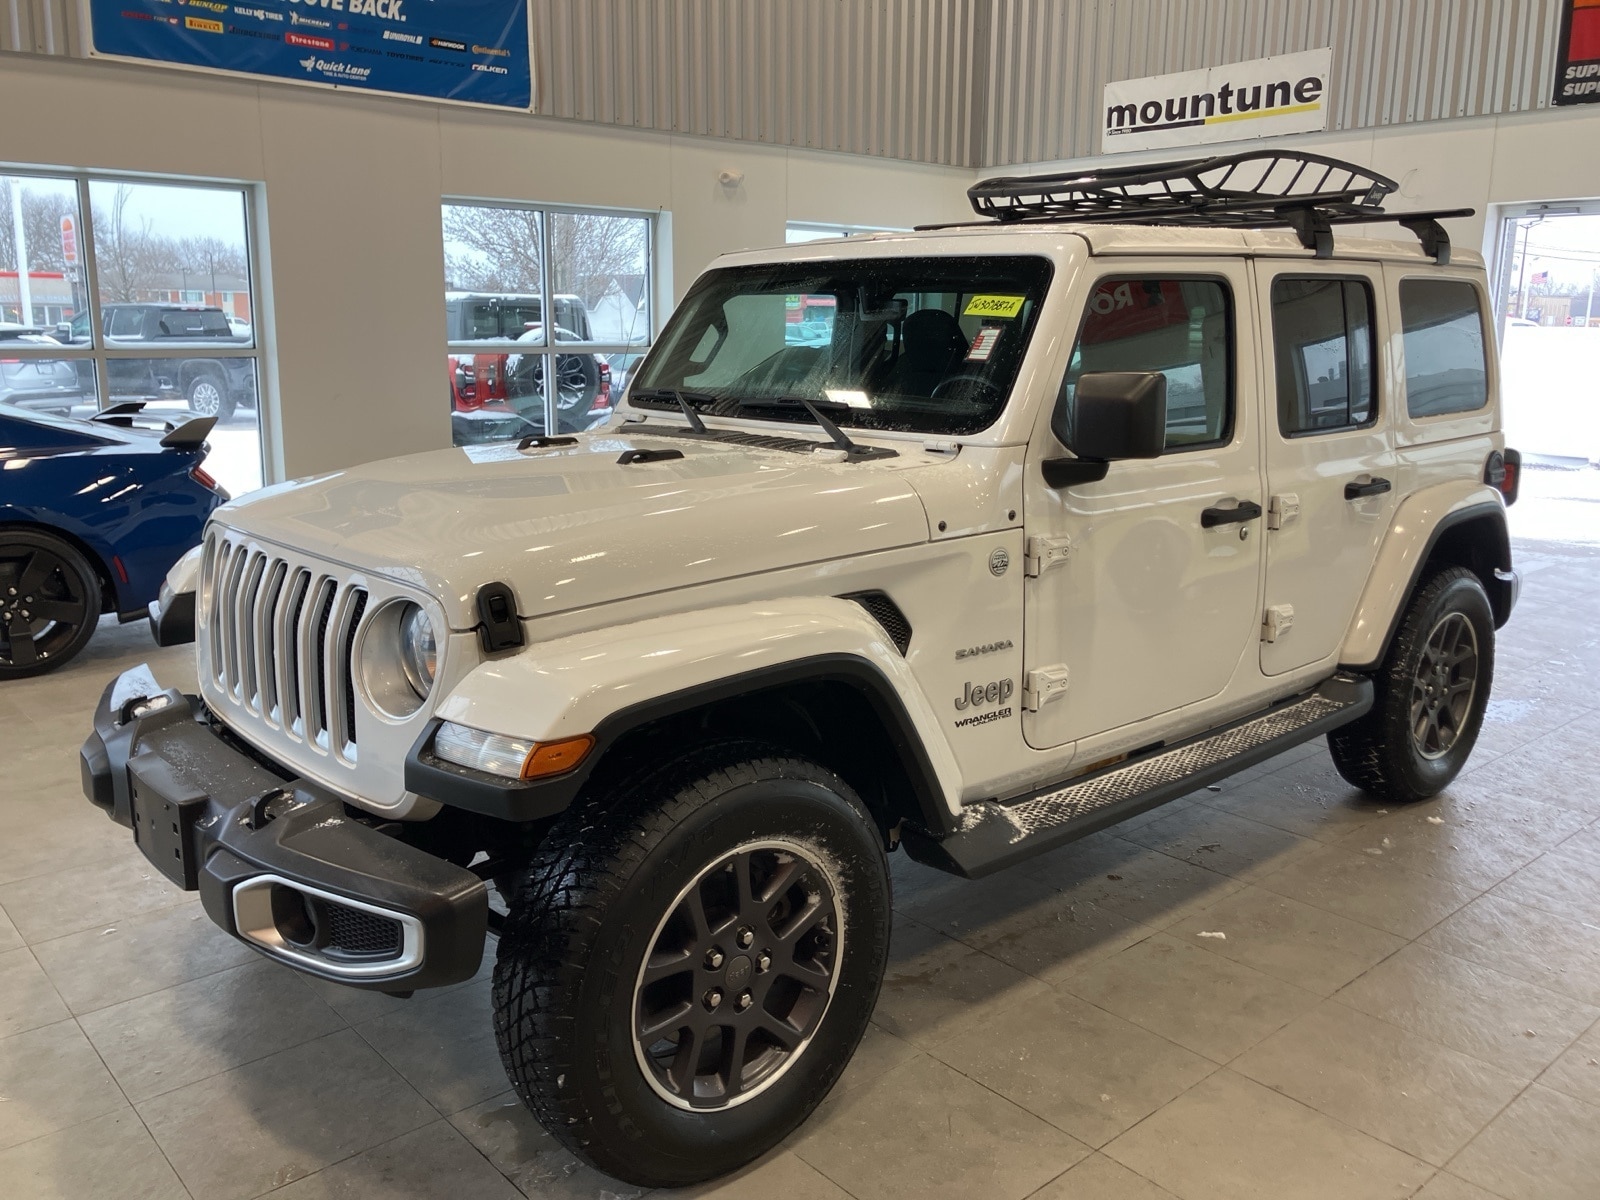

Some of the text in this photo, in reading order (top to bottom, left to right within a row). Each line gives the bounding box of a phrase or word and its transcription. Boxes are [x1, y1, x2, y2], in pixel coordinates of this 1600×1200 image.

[234, 6, 254, 16] KELLY
[265, 11, 283, 21] TIRES
[349, 0, 406, 21] BACK.
[188, 19, 221, 31] PIRELLI
[299, 17, 331, 28] MICHELIN
[290, 35, 330, 48] Firestone
[388, 31, 418, 44] UNIROYAL
[386, 51, 405, 59] TOYO
[472, 44, 507, 56] Continental
[316, 59, 371, 76] Quick Lane
[471, 63, 508, 74] FALKEN
[1565, 64, 1600, 79] SUP
[1107, 76, 1323, 128] mountune
[955, 640, 1013, 660] SAHARA
[954, 677, 1014, 711] Jeep
[954, 707, 1012, 728] WRANGLER
[973, 713, 1012, 727] UNLIMITED
